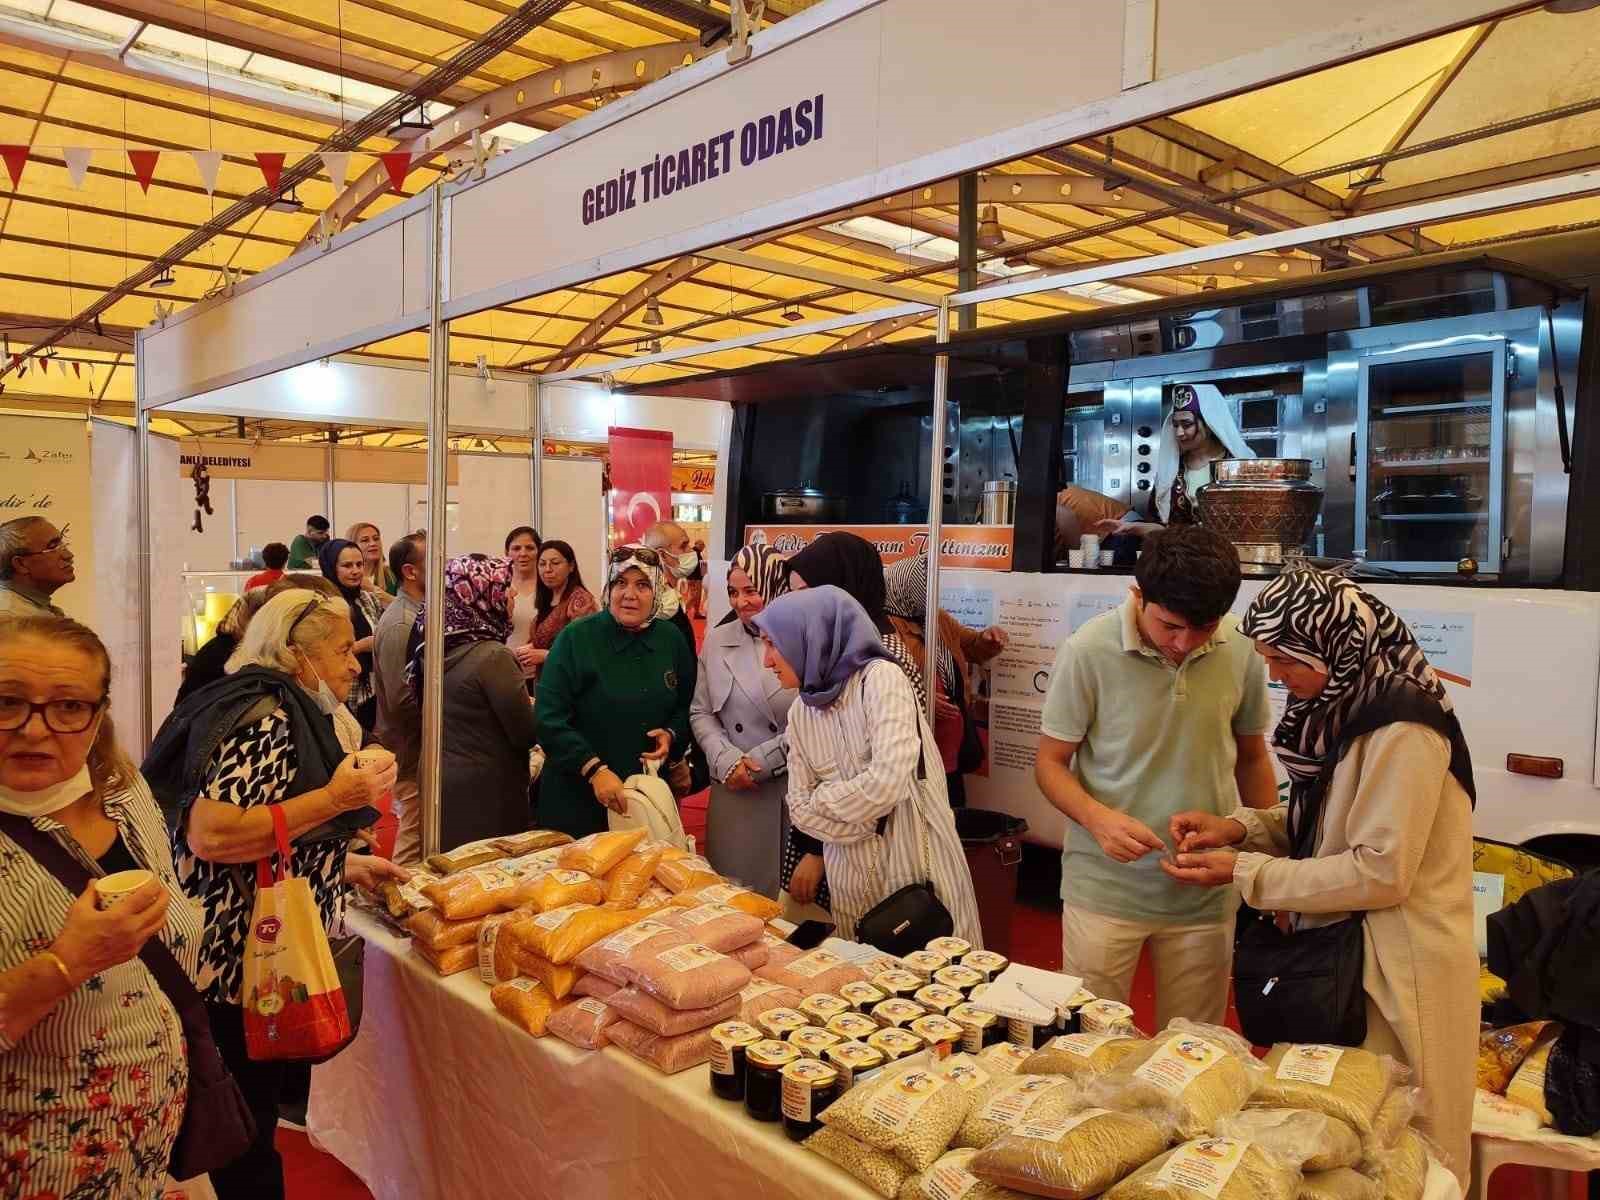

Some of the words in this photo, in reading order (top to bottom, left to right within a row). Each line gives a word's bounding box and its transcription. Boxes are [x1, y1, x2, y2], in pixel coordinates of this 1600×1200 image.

[582, 168, 637, 225] GEDİZ
[640, 130, 735, 203] TİCARET
[740, 94, 824, 167] ODASI
[202, 456, 251, 467] BELEDİYESİ
